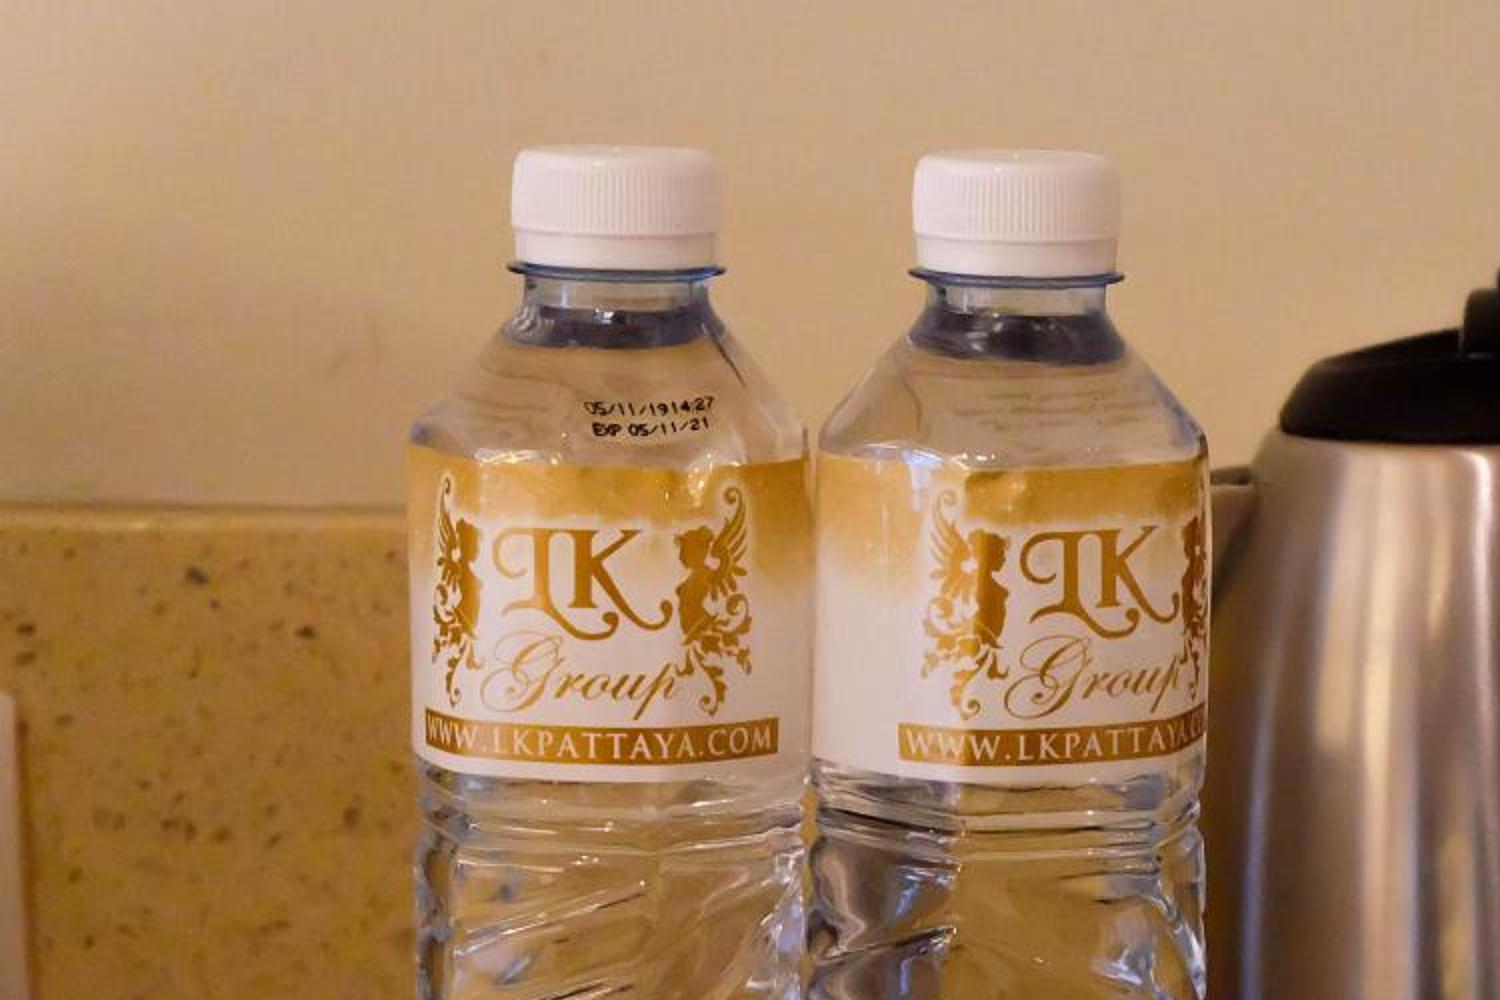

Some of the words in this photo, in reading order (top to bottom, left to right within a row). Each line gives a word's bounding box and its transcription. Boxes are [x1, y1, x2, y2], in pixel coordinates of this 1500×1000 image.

[591, 421, 621, 437] EXP
[627, 416, 709, 437] 05/11/21
[492, 526, 674, 641] LK
[1018, 525, 1181, 639] LK
[479, 630, 680, 721] Group
[1003, 634, 1180, 719] Group
[426, 713, 772, 761] WWW.LKPATTAYA.COM
